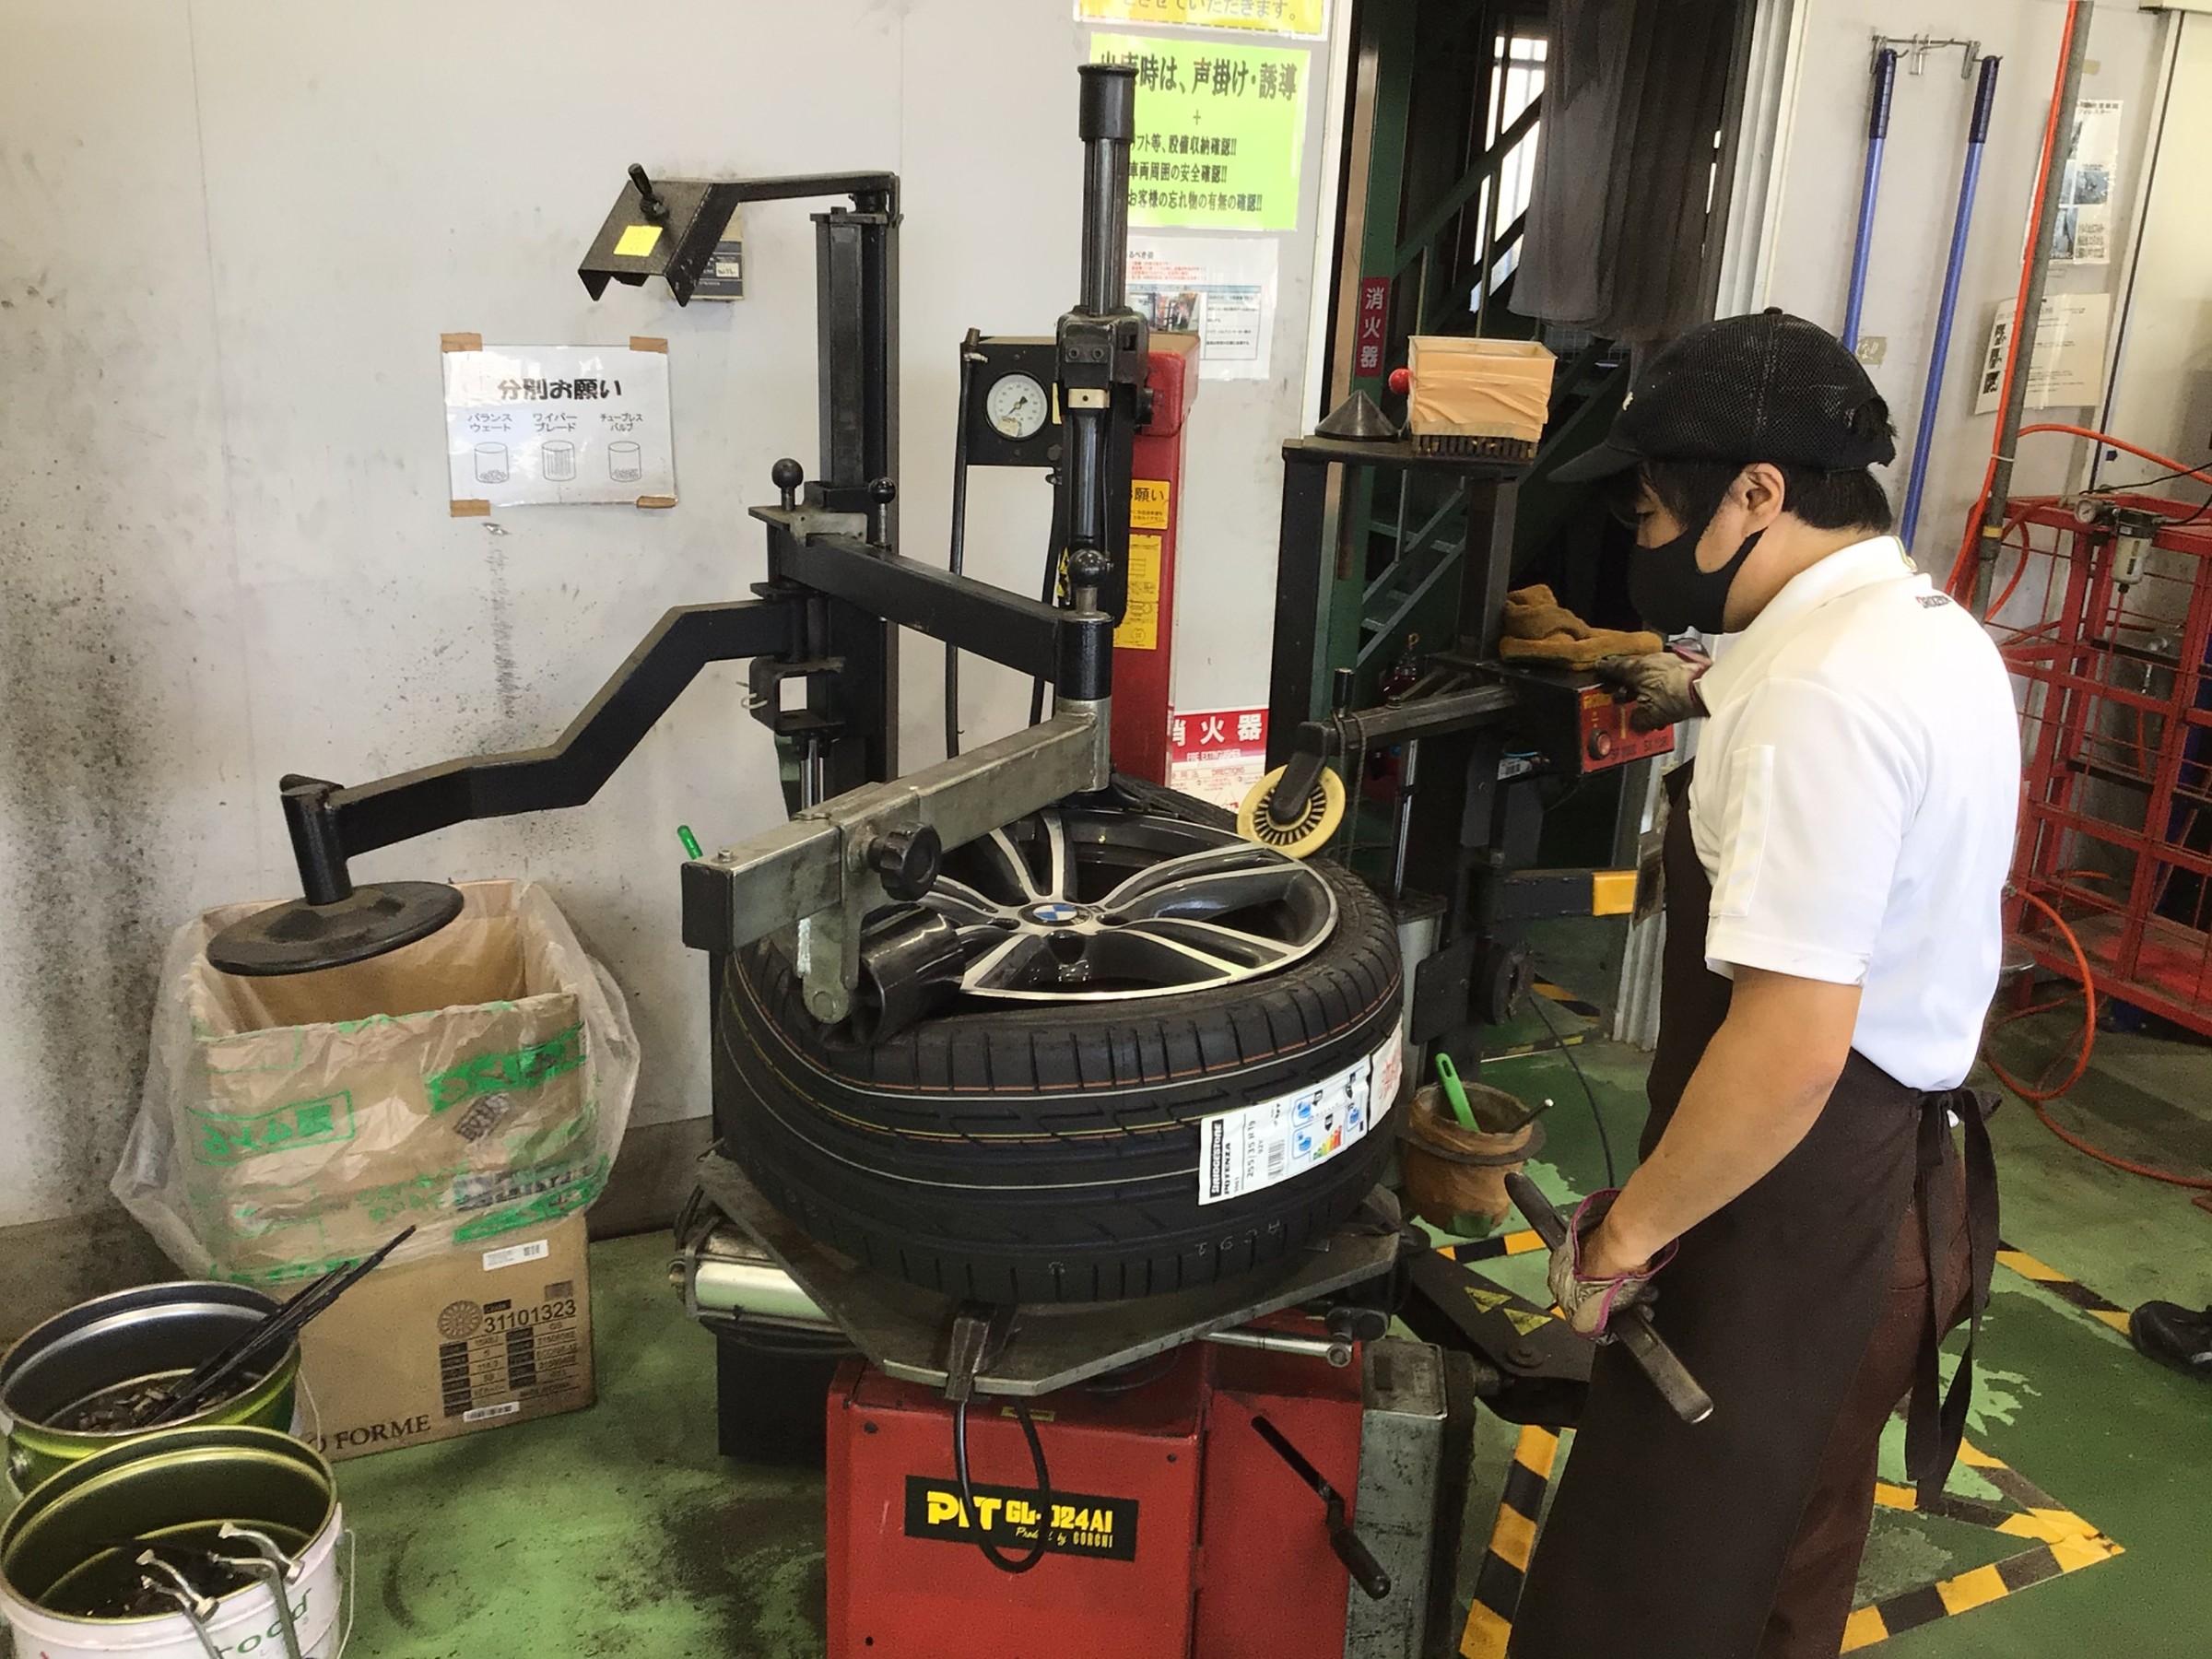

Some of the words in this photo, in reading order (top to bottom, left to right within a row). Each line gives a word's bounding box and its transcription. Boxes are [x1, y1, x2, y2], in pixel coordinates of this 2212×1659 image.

[1359, 287, 1384, 369] 消火器
[497, 378, 622, 400] 分別お願い
[467, 413, 512, 422] バランス
[1130, 487, 1165, 503] 願い
[484, 1299, 577, 1334] 31101323
[335, 1414, 431, 1451] FORME
